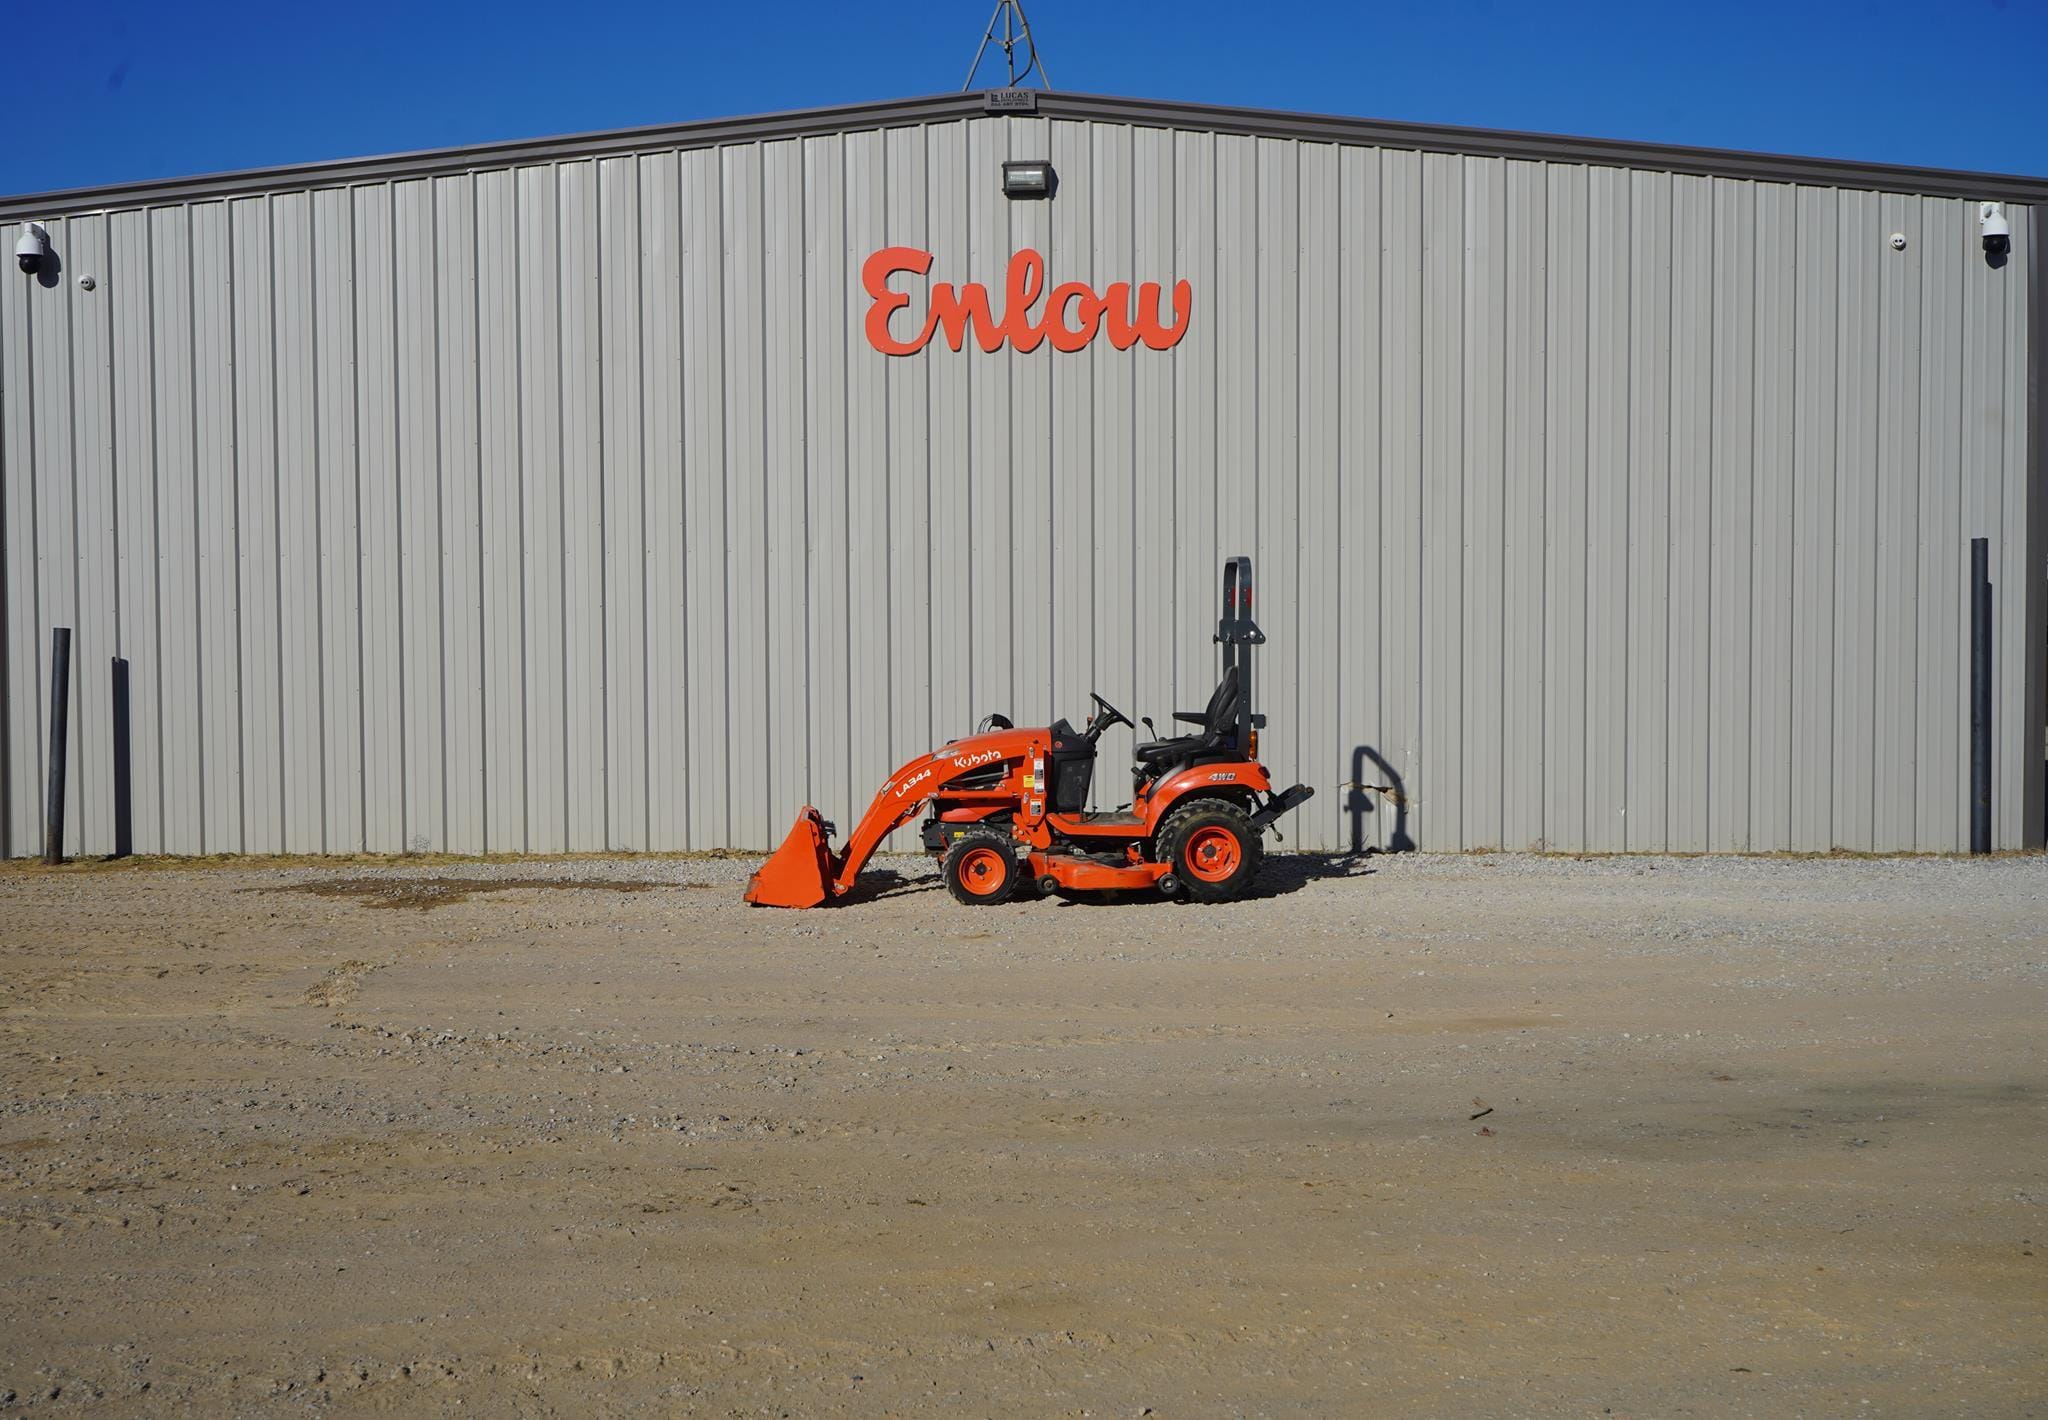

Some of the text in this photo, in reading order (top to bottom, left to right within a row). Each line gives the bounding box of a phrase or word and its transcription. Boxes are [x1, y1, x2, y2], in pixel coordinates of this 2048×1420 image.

[954, 750, 1002, 768] Kubota
[895, 769, 931, 798] LA344
[1208, 772, 1236, 781] 4WD
